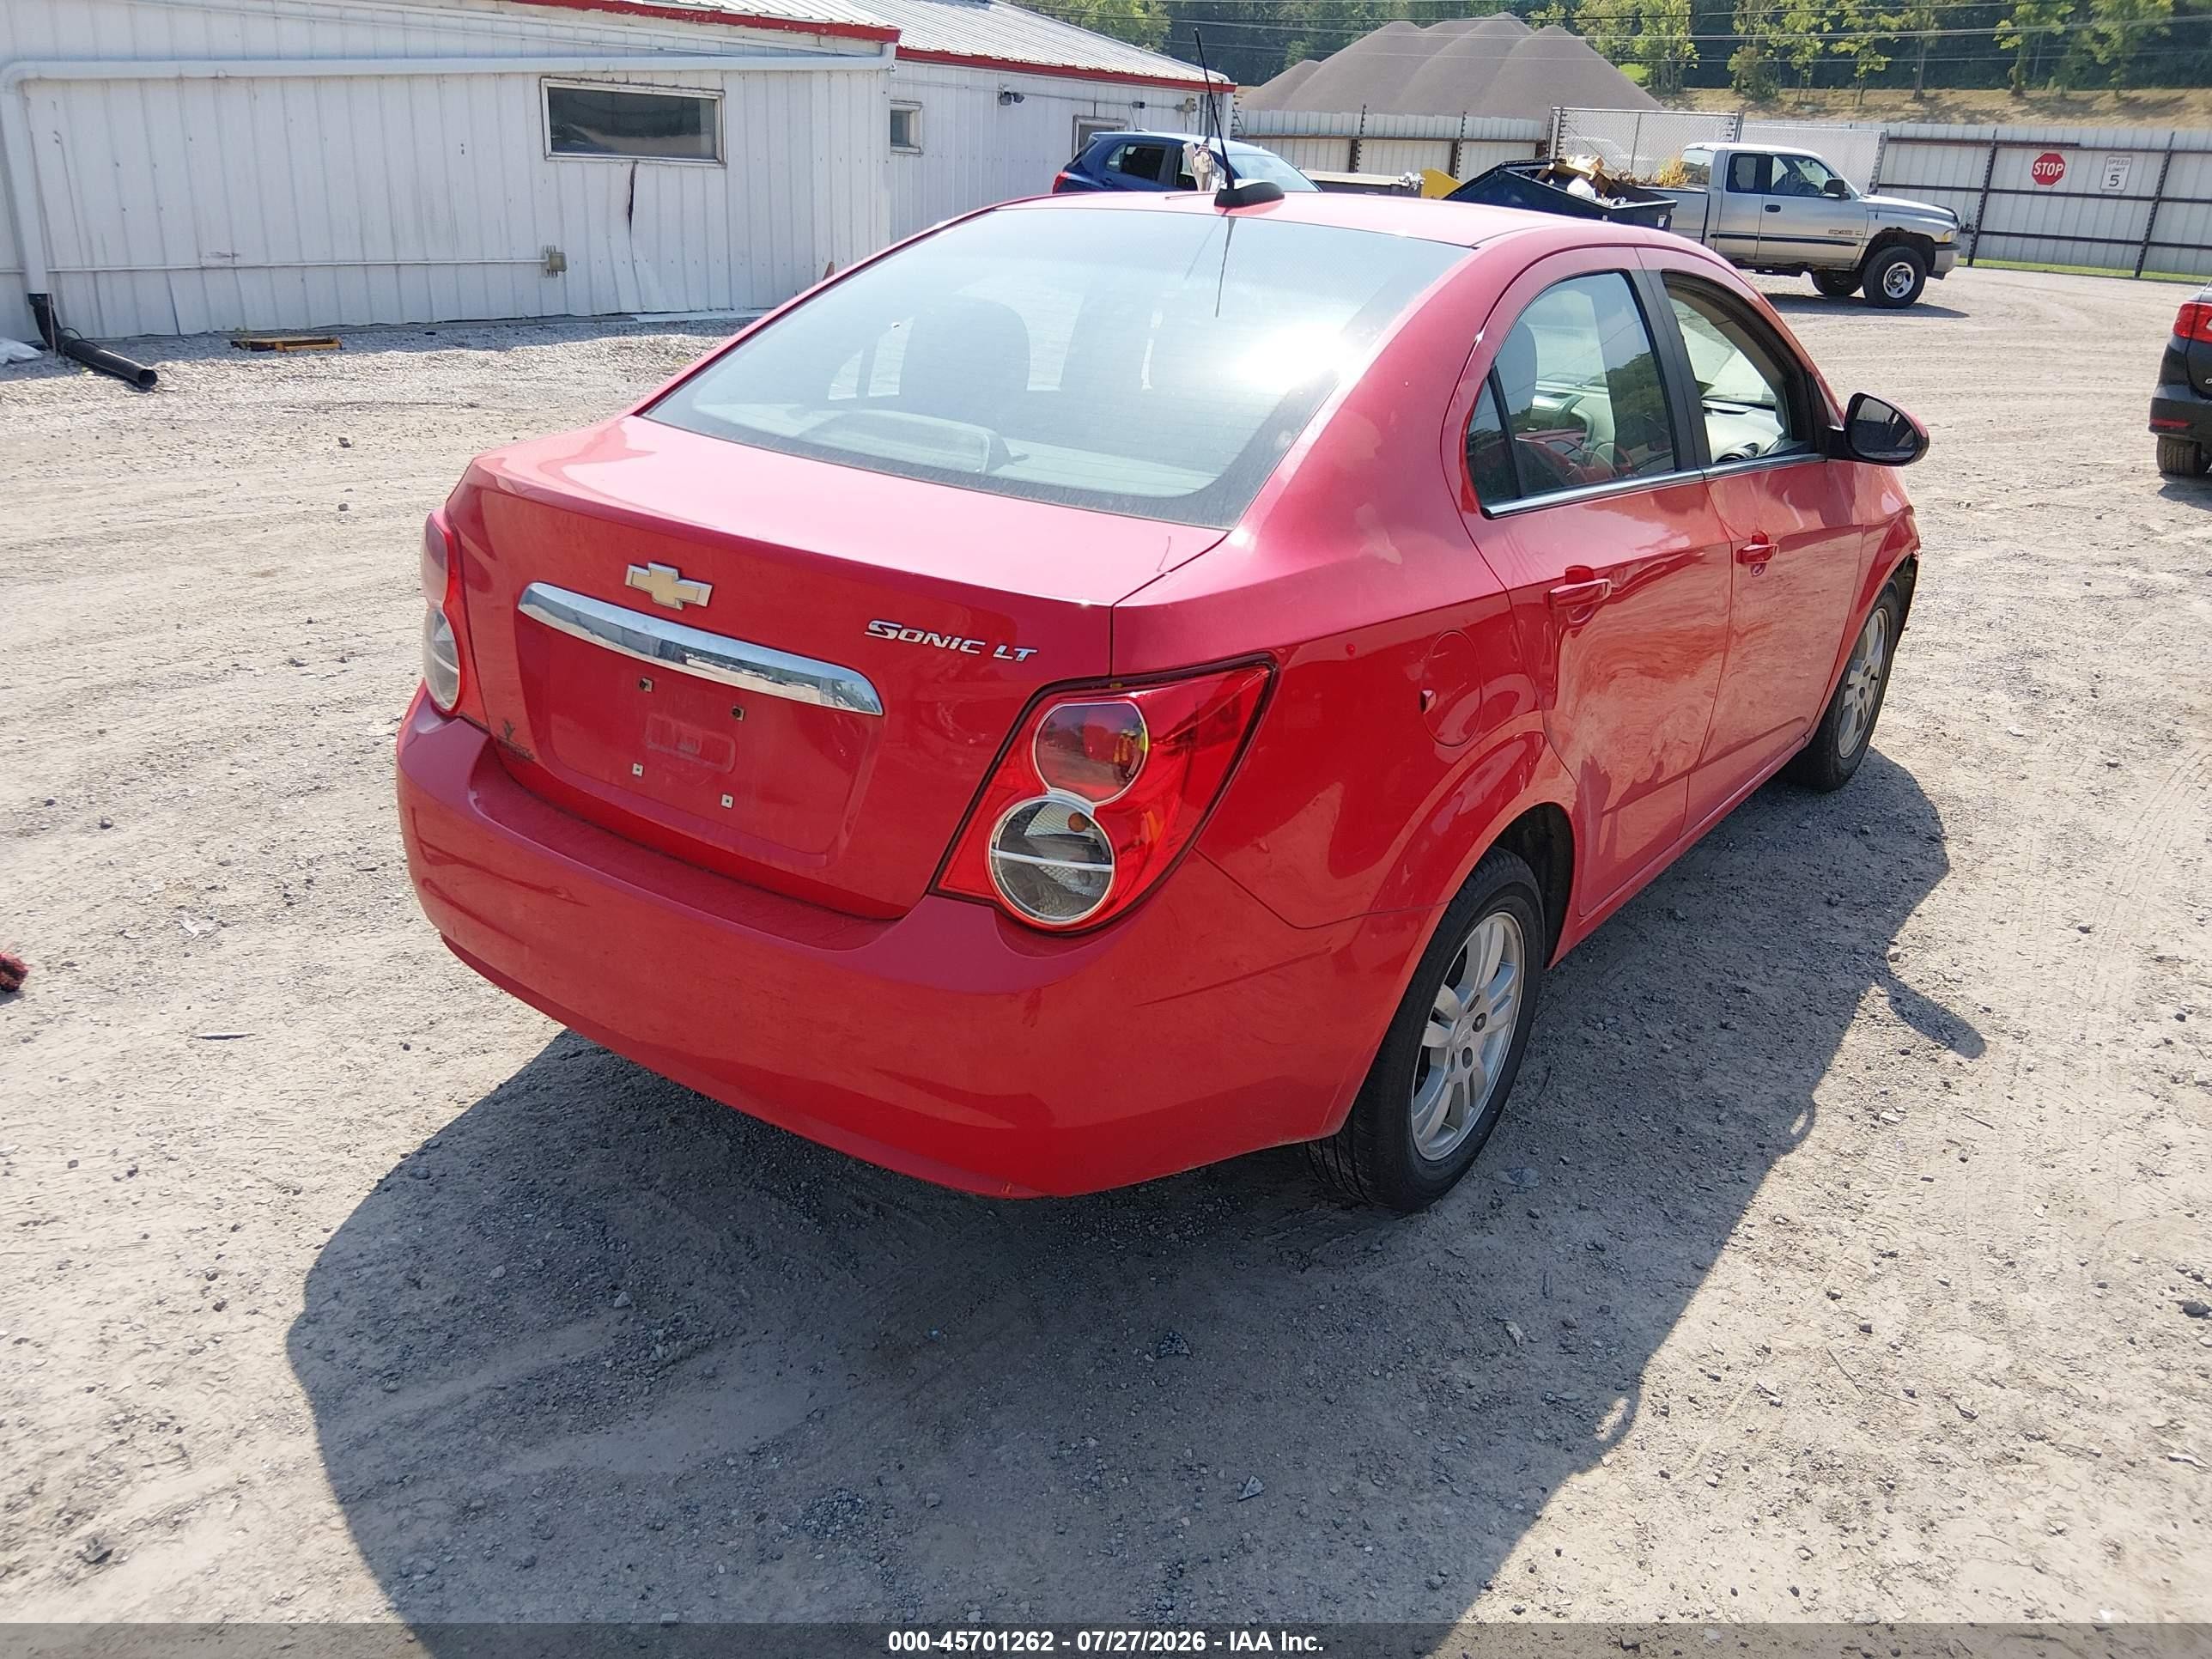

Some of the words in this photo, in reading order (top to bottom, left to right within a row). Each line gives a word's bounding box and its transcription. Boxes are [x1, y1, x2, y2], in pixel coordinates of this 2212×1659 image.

[2033, 161, 2064, 177] STOP
[2108, 174, 2120, 187] 5
[863, 619, 987, 655] SONIC
[992, 644, 1038, 662] LT
